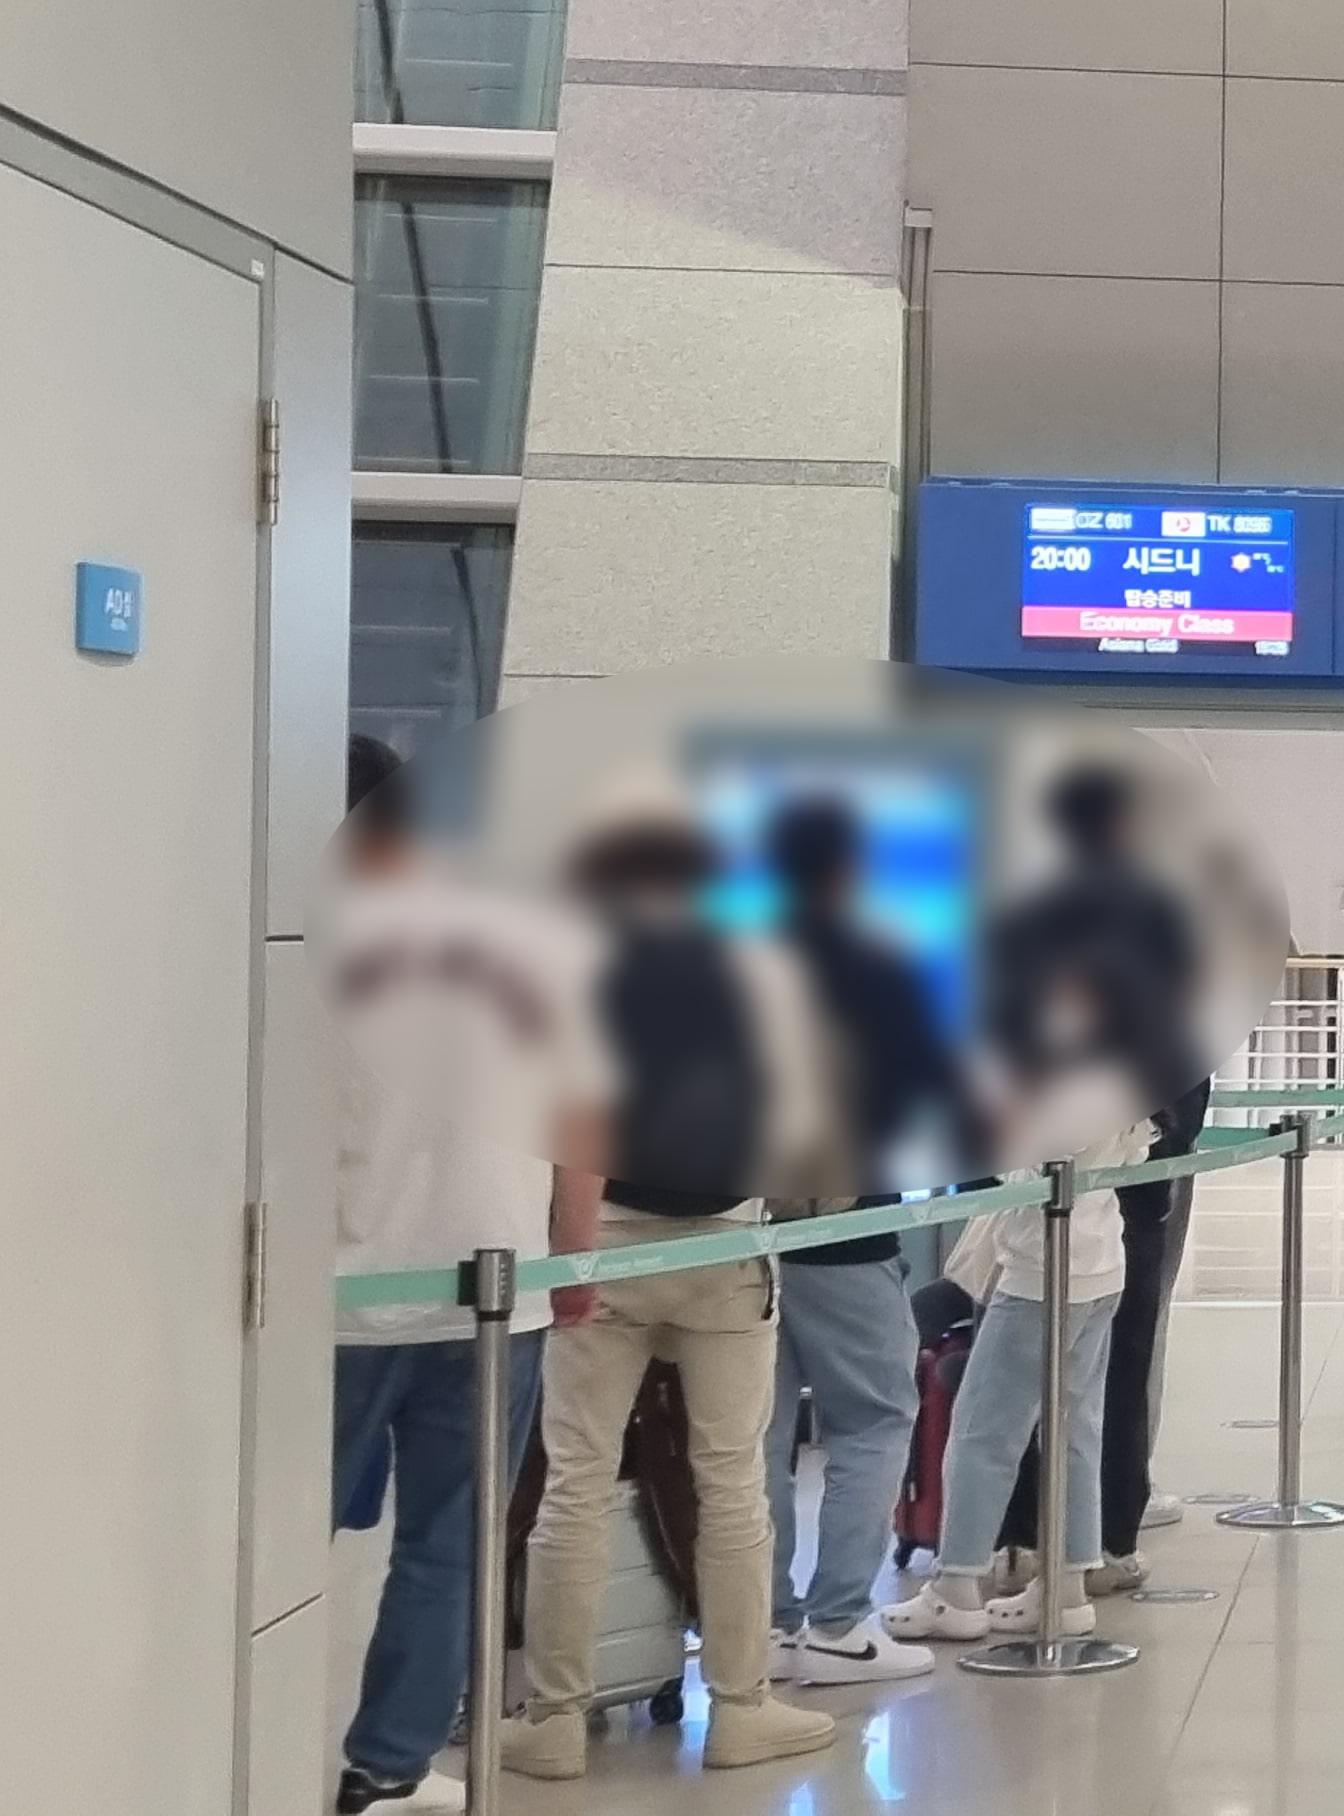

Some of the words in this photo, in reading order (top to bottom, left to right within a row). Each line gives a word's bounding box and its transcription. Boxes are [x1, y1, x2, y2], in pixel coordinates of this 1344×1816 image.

[1075, 512, 1104, 529] OZ
[1208, 515, 1231, 532] TK
[1031, 546, 1091, 571] 20:00
[1122, 546, 1200, 576] 시드니
[1124, 589, 1192, 608] 탑승준비
[1080, 611, 1173, 635] Economy
[1177, 613, 1235, 634] Class
